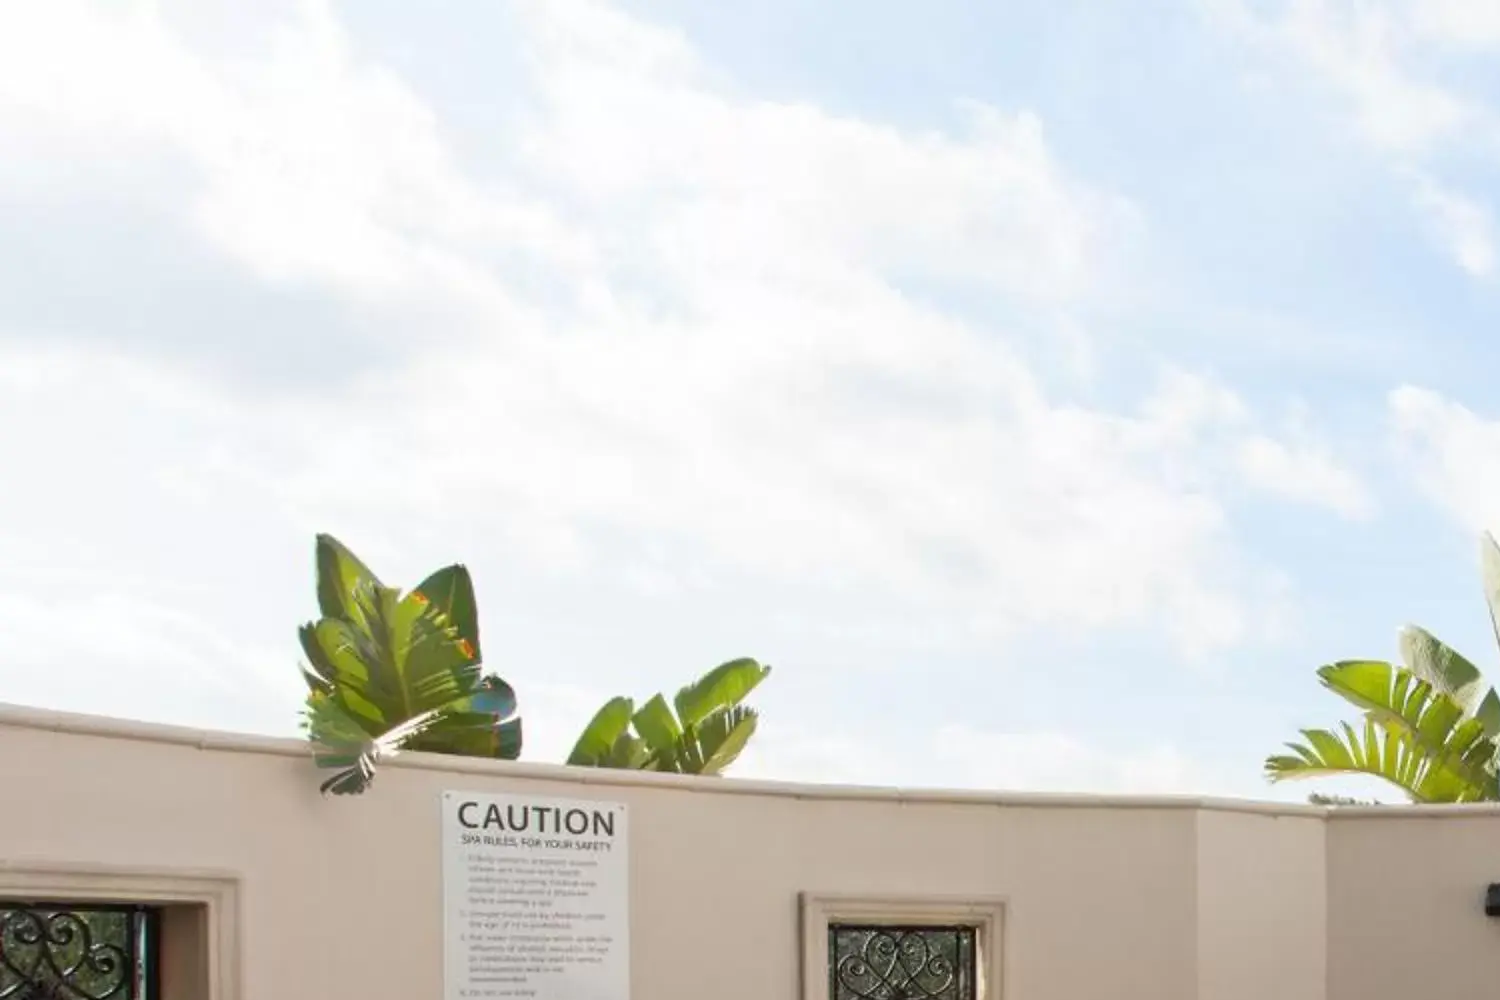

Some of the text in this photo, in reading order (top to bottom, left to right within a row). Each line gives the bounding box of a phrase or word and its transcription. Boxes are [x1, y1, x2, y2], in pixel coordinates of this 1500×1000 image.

[457, 801, 614, 836] CAUTION
[461, 835, 481, 846] SPA
[521, 837, 542, 848] FOR
[544, 838, 572, 849] YOUR
[574, 839, 612, 852] SAFETY
